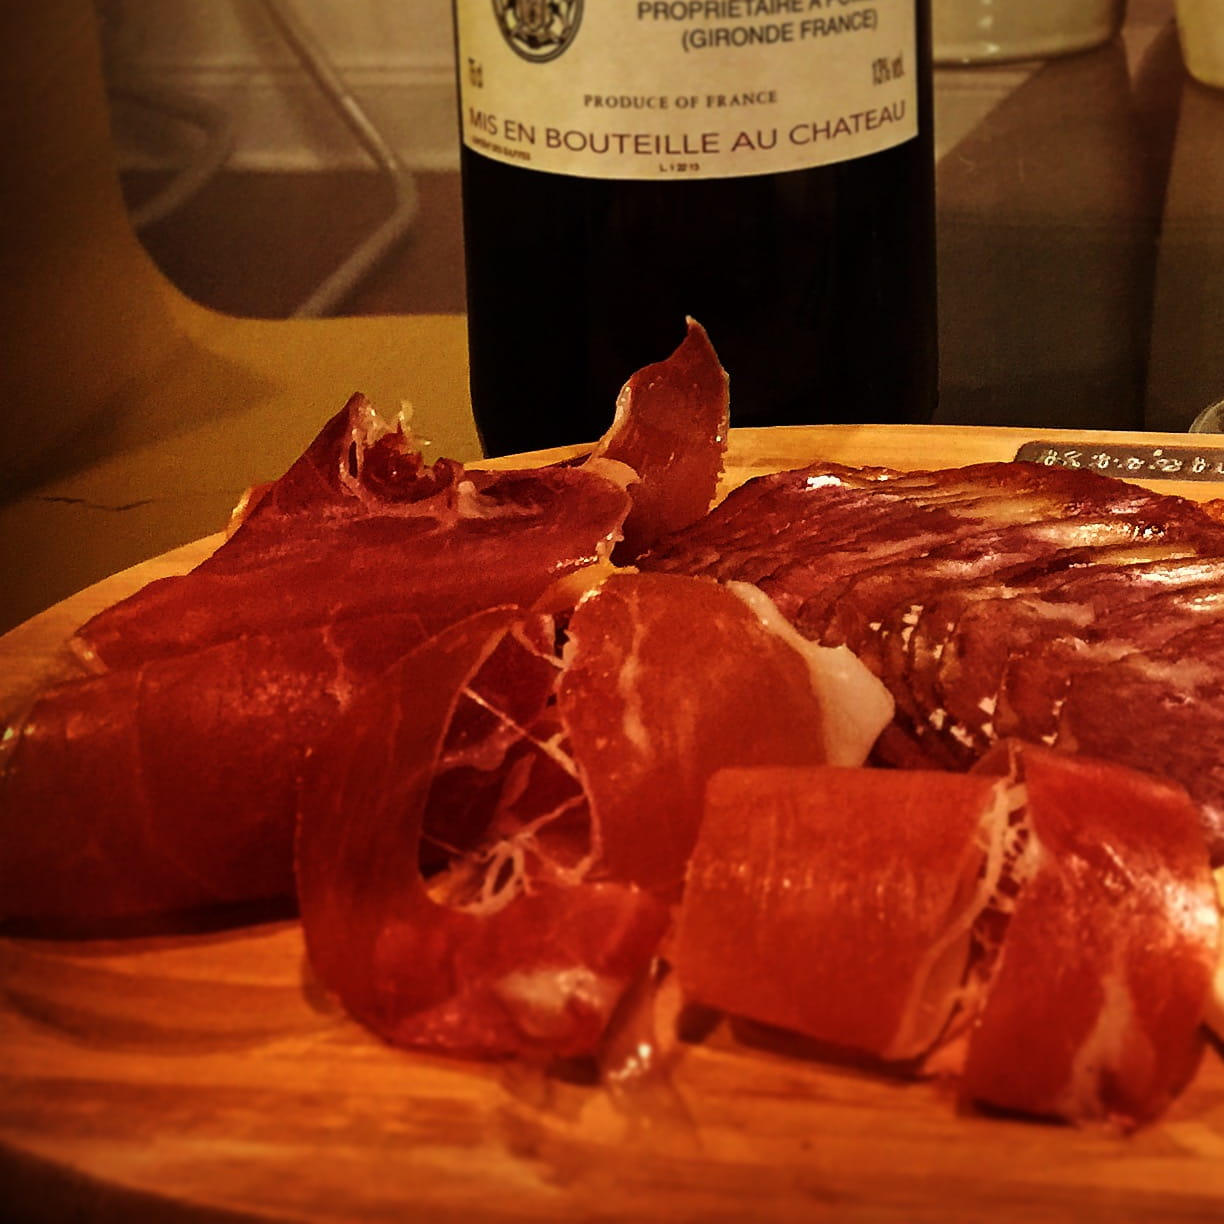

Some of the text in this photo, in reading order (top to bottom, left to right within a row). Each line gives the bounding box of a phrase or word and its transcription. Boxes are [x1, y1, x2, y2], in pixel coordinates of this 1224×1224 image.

[680, 7, 880, 53] (GIRONDE FRANCE)
[583, 88, 779, 110] PRODUCE OF FRANCE
[469, 107, 499, 136] MIS
[504, 119, 537, 145] EN
[546, 127, 721, 156] BOUTEILLE
[730, 127, 780, 154] AU
[788, 99, 907, 147] CHATEAU
